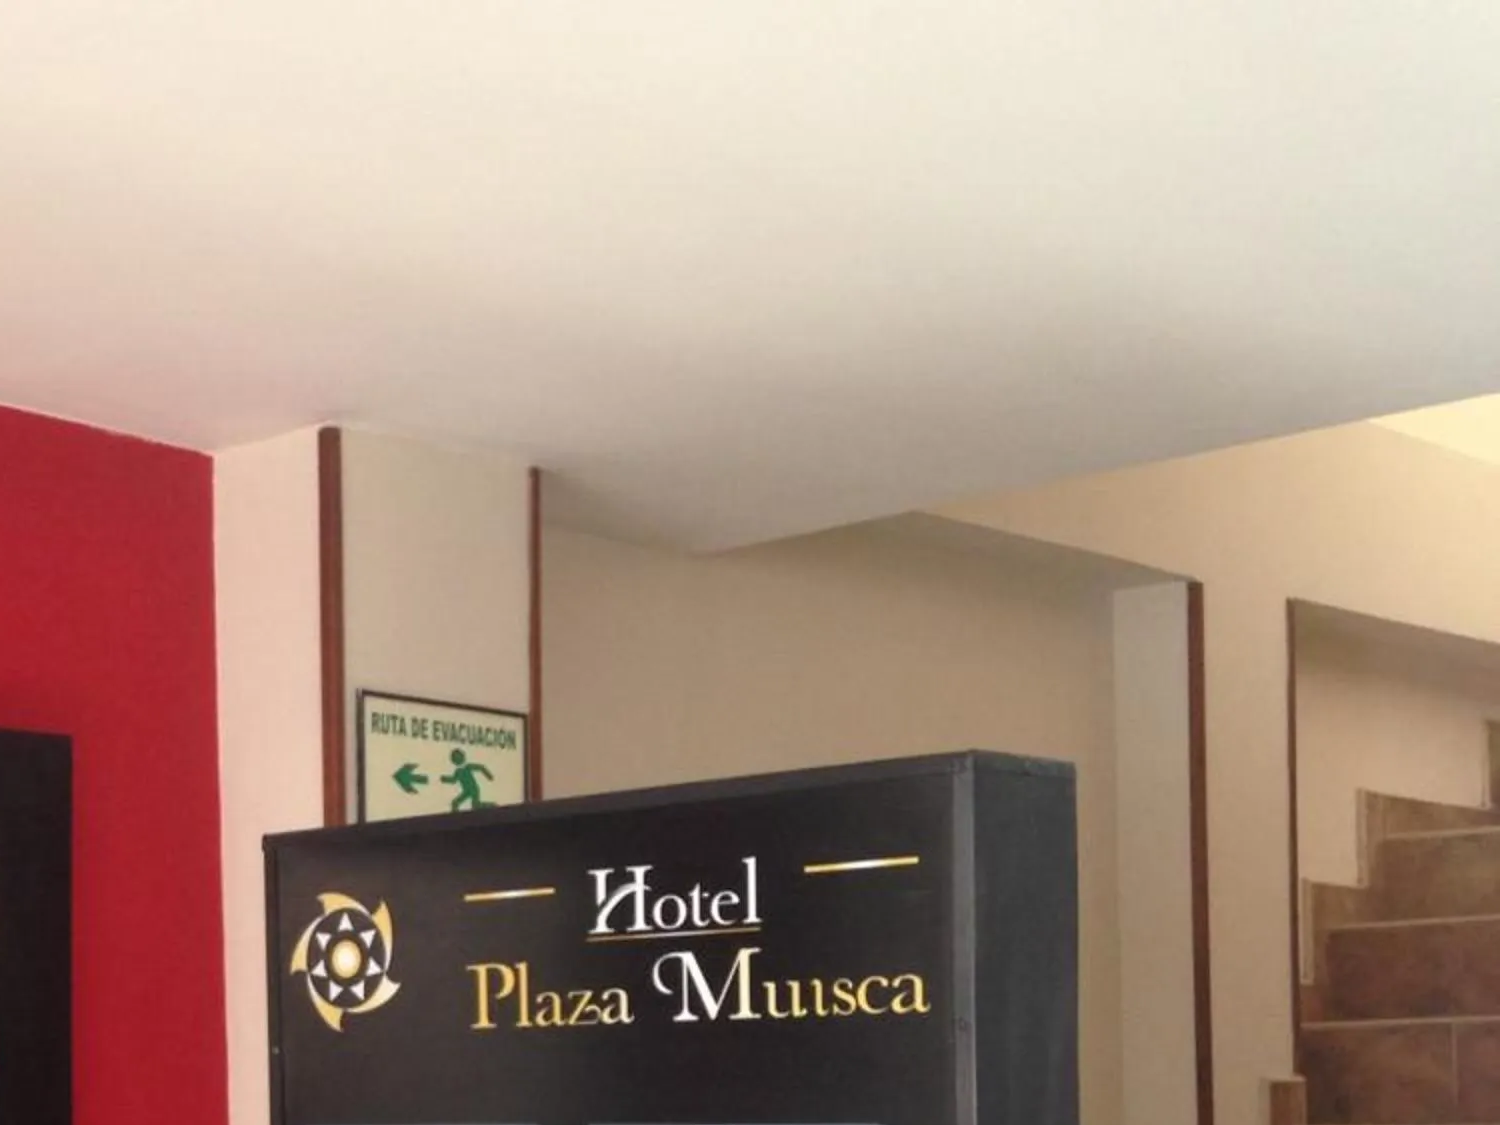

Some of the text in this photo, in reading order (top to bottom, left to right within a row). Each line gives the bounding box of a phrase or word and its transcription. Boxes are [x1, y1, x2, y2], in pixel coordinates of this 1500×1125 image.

[371, 712, 406, 736] RUTA
[411, 717, 430, 740] DE
[587, 856, 763, 935] Hotel
[465, 961, 635, 1030] Plaza
